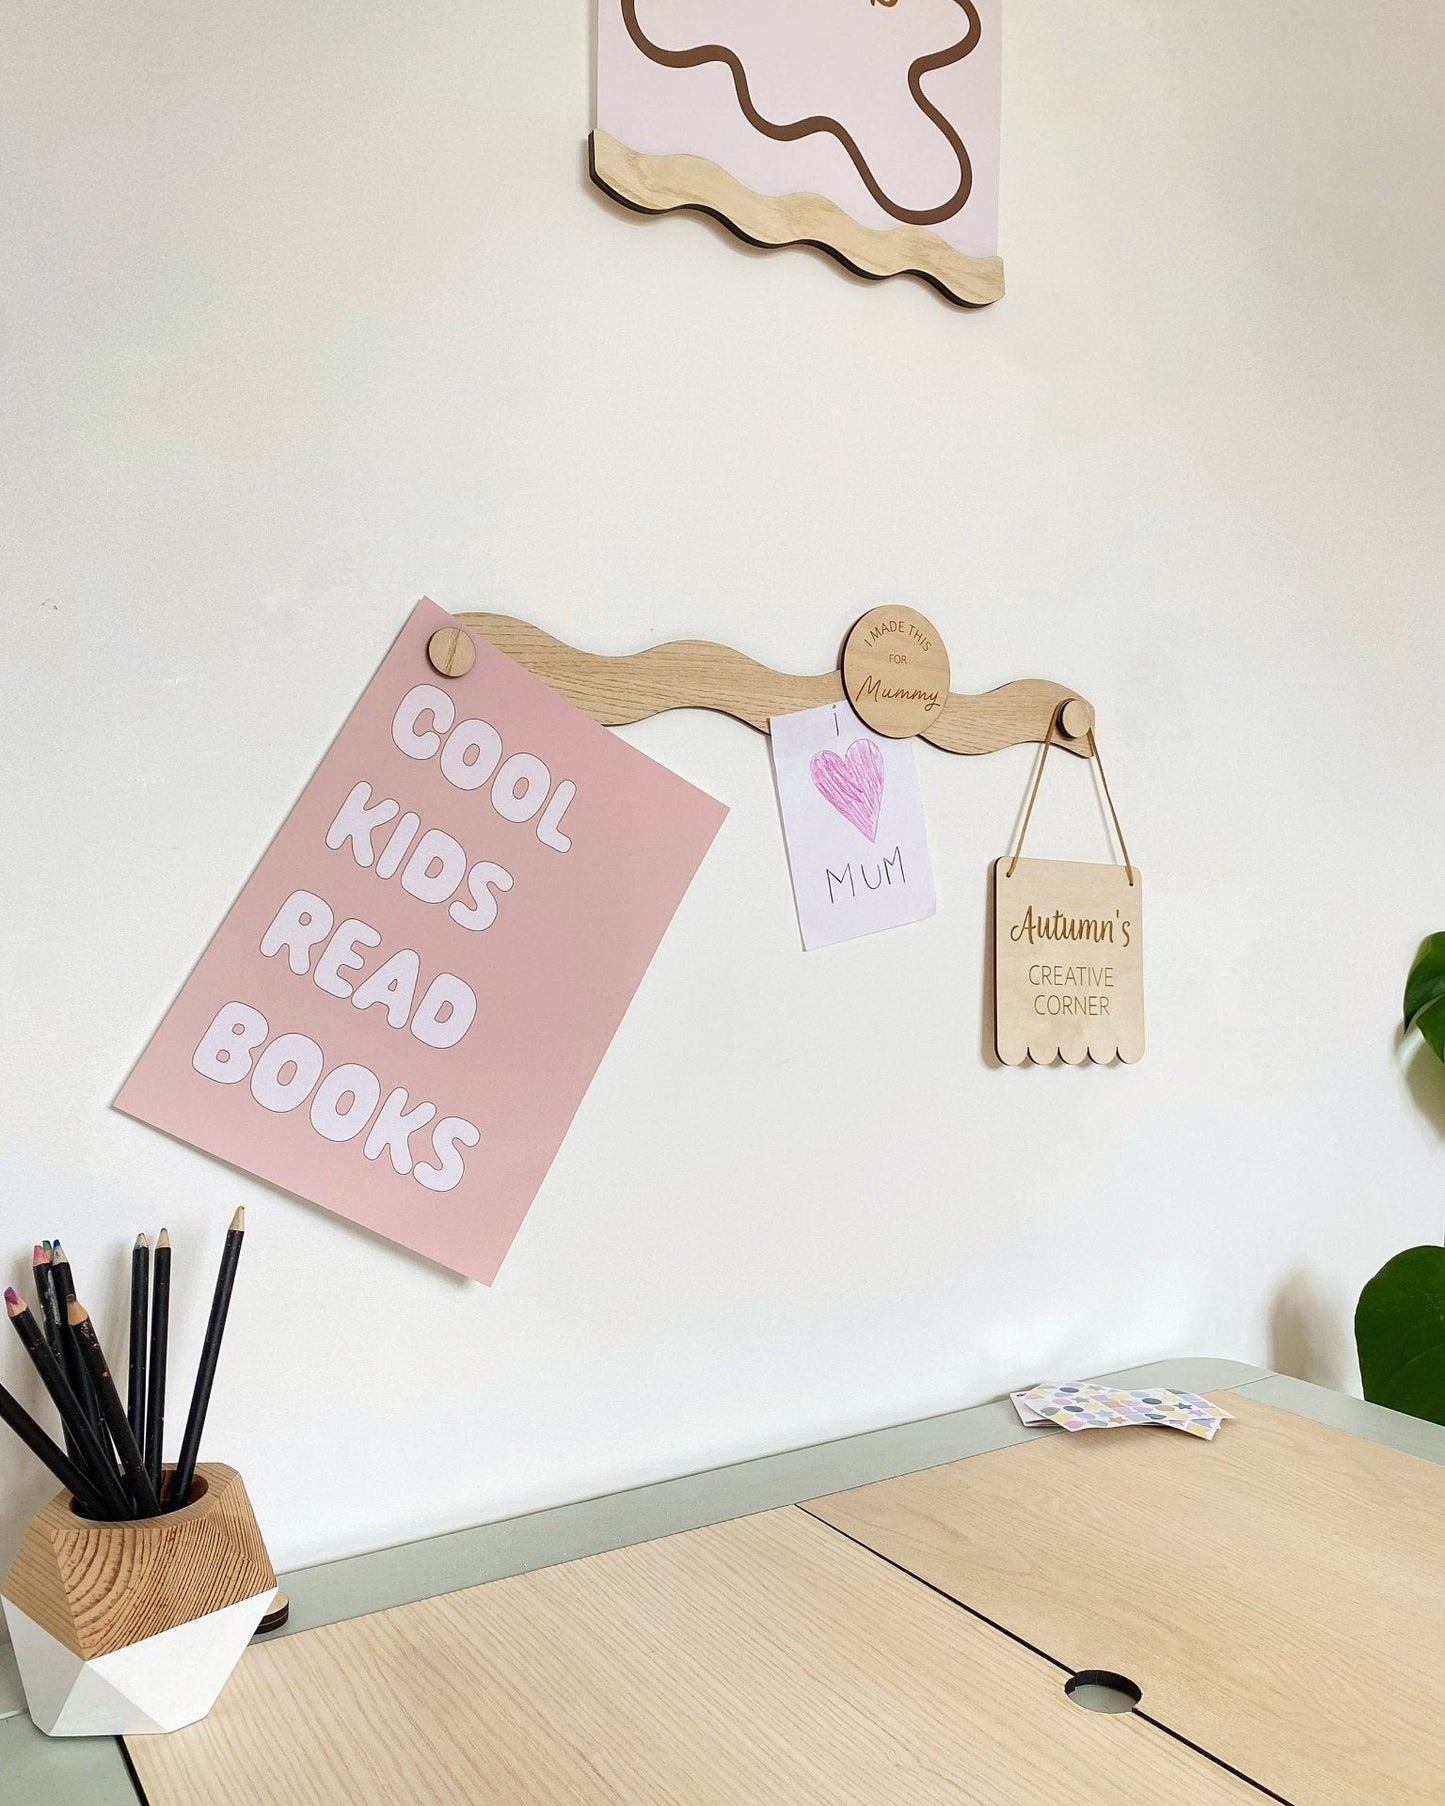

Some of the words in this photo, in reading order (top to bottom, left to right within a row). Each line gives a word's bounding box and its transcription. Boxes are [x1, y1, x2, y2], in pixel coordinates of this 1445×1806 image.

[864, 638, 872, 647] I
[870, 620, 905, 641] MADE
[908, 623, 932, 652] THIS
[889, 653, 907, 664] FOR
[855, 672, 941, 712] Mummy
[391, 683, 577, 853] COOL
[325, 781, 514, 931] KIDS
[826, 846, 906, 904] MUM
[1010, 905, 1131, 947] Autumn's
[260, 889, 477, 1049] READ
[1028, 964, 1115, 987] CREATIVE
[1034, 994, 1110, 1016] CORNER
[192, 1001, 481, 1192] BOOKS
